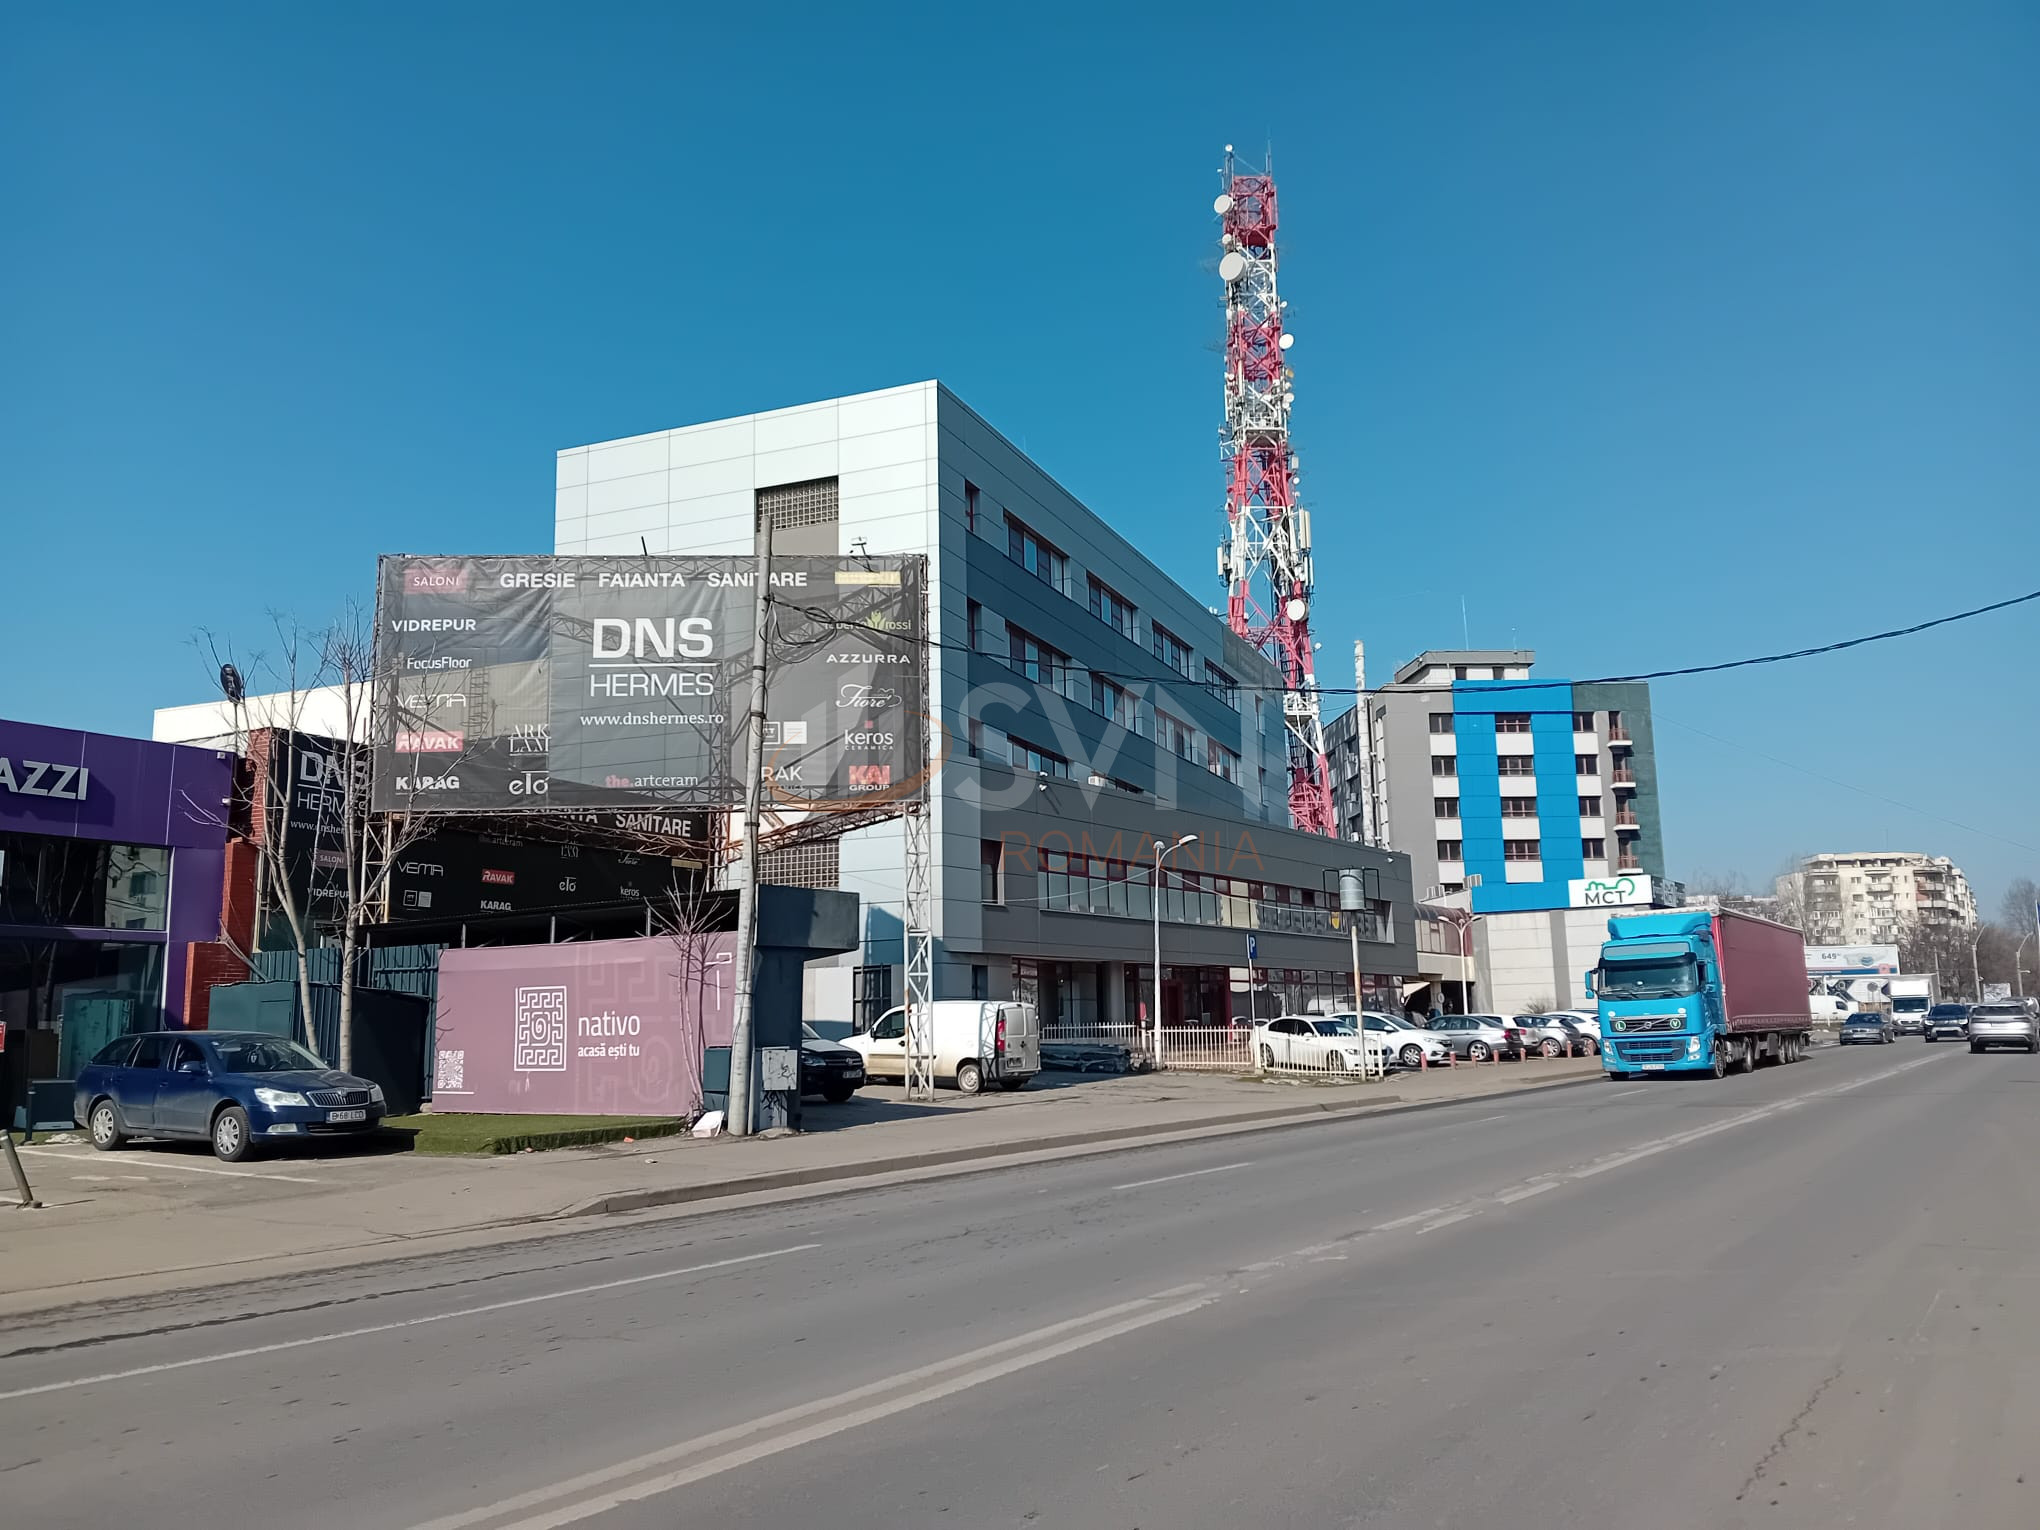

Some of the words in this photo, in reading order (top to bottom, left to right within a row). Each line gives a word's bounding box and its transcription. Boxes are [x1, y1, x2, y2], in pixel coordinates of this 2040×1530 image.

[413, 576, 460, 587] SALONI
[500, 572, 576, 588] GRESIE
[598, 572, 686, 588] FAIANTA
[706, 571, 808, 588] SANIARE
[391, 618, 477, 632] VIDREPUR
[884, 619, 912, 630] rossi
[592, 617, 714, 659] DNS
[406, 656, 473, 670] FocusFloor
[826, 653, 911, 664] AZZURRA
[589, 672, 715, 697] HERMES
[580, 711, 725, 726] www.dnshermes.ro
[844, 729, 894, 745] keros
[395, 775, 461, 791] KARAG
[849, 784, 891, 792] GROUP
[615, 813, 692, 838] SANITARE
[319, 854, 345, 865] SALONI
[397, 861, 444, 877] VEMA
[482, 871, 514, 884] RAVAK
[620, 886, 640, 897] keros
[1584, 890, 1627, 905] MCT
[480, 900, 512, 911] KARAG
[1250, 936, 1256, 953] P
[578, 1010, 641, 1037] nativo
[577, 1042, 606, 1057] acasă
[607, 1042, 627, 1060] ești
[628, 1043, 640, 1057] tu
